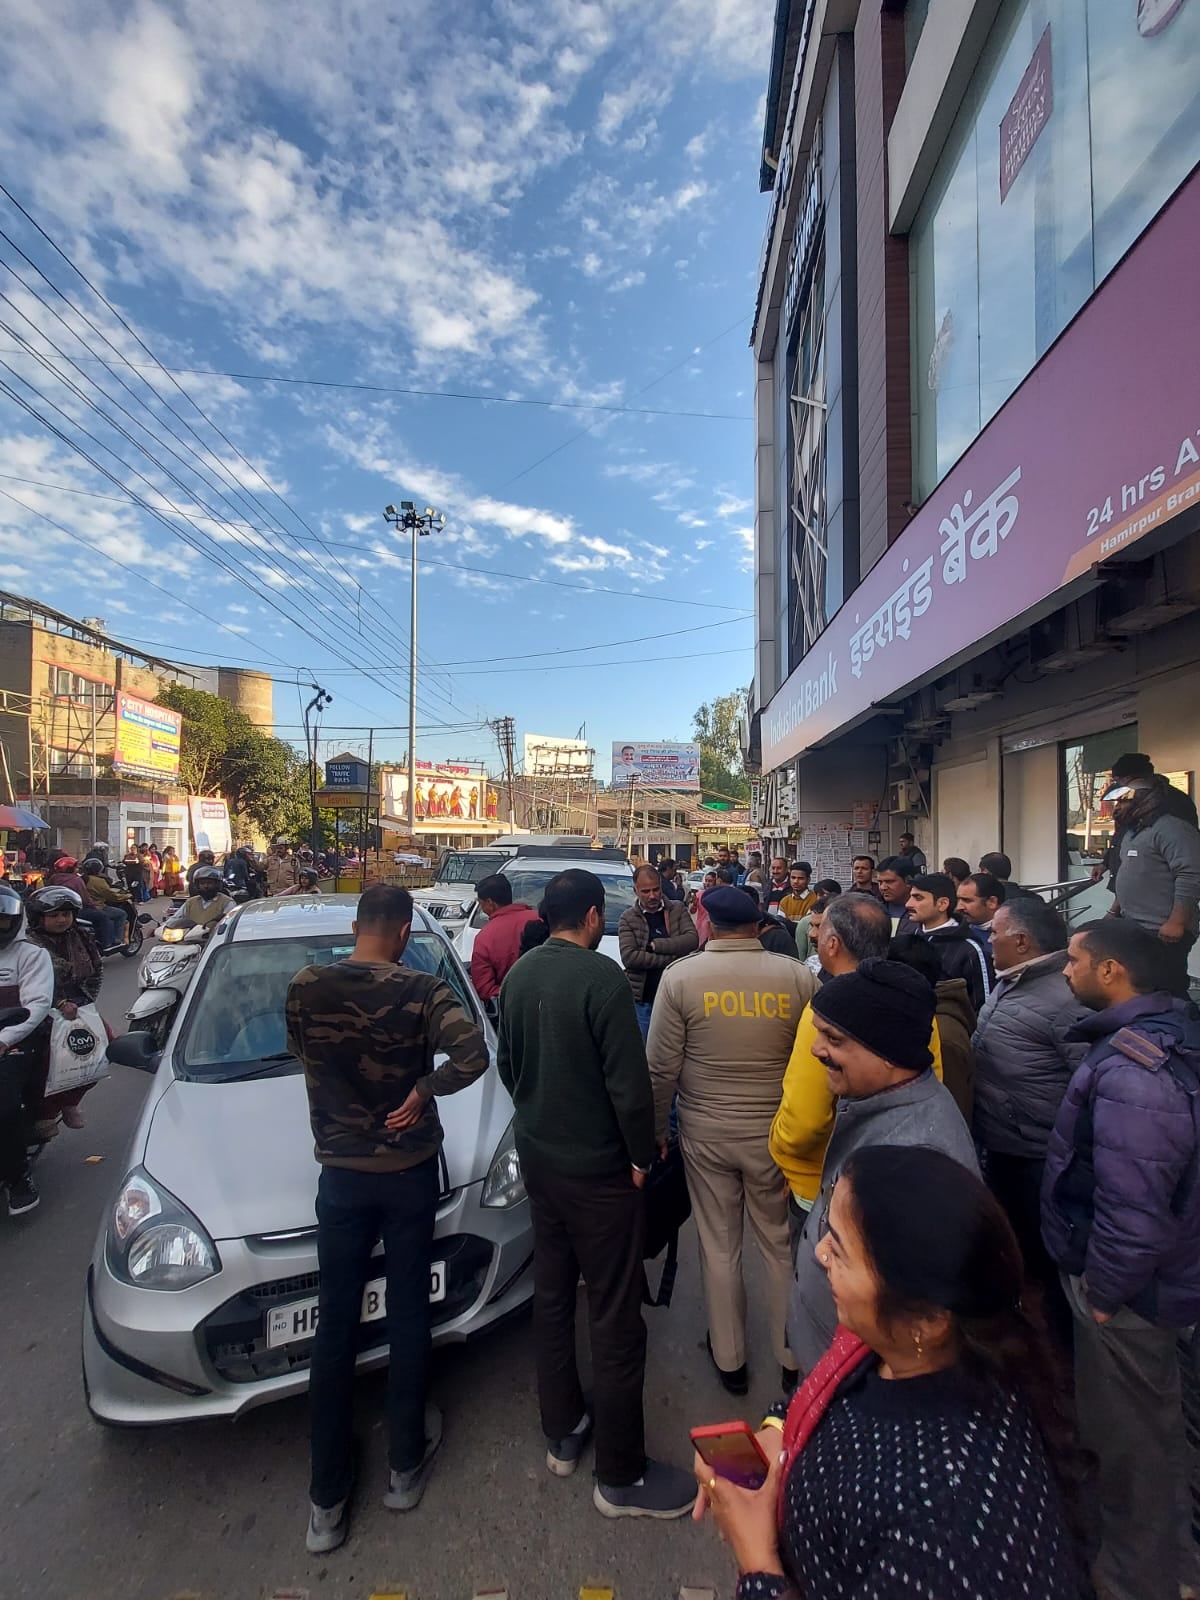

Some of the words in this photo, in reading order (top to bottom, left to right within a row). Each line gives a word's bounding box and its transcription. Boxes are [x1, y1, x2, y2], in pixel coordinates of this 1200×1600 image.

[1086, 496, 1114, 537] 24
[1121, 465, 1165, 512] hrs
[1174, 428, 1200, 476] A
[1100, 506, 1162, 554] Hamirpur
[849, 556, 934, 679] इंडसइंड
[938, 465, 1022, 585] बैंक
[805, 650, 838, 718] Bank
[703, 990, 792, 1019] POLICE
[272, 1320, 288, 1333] IND
